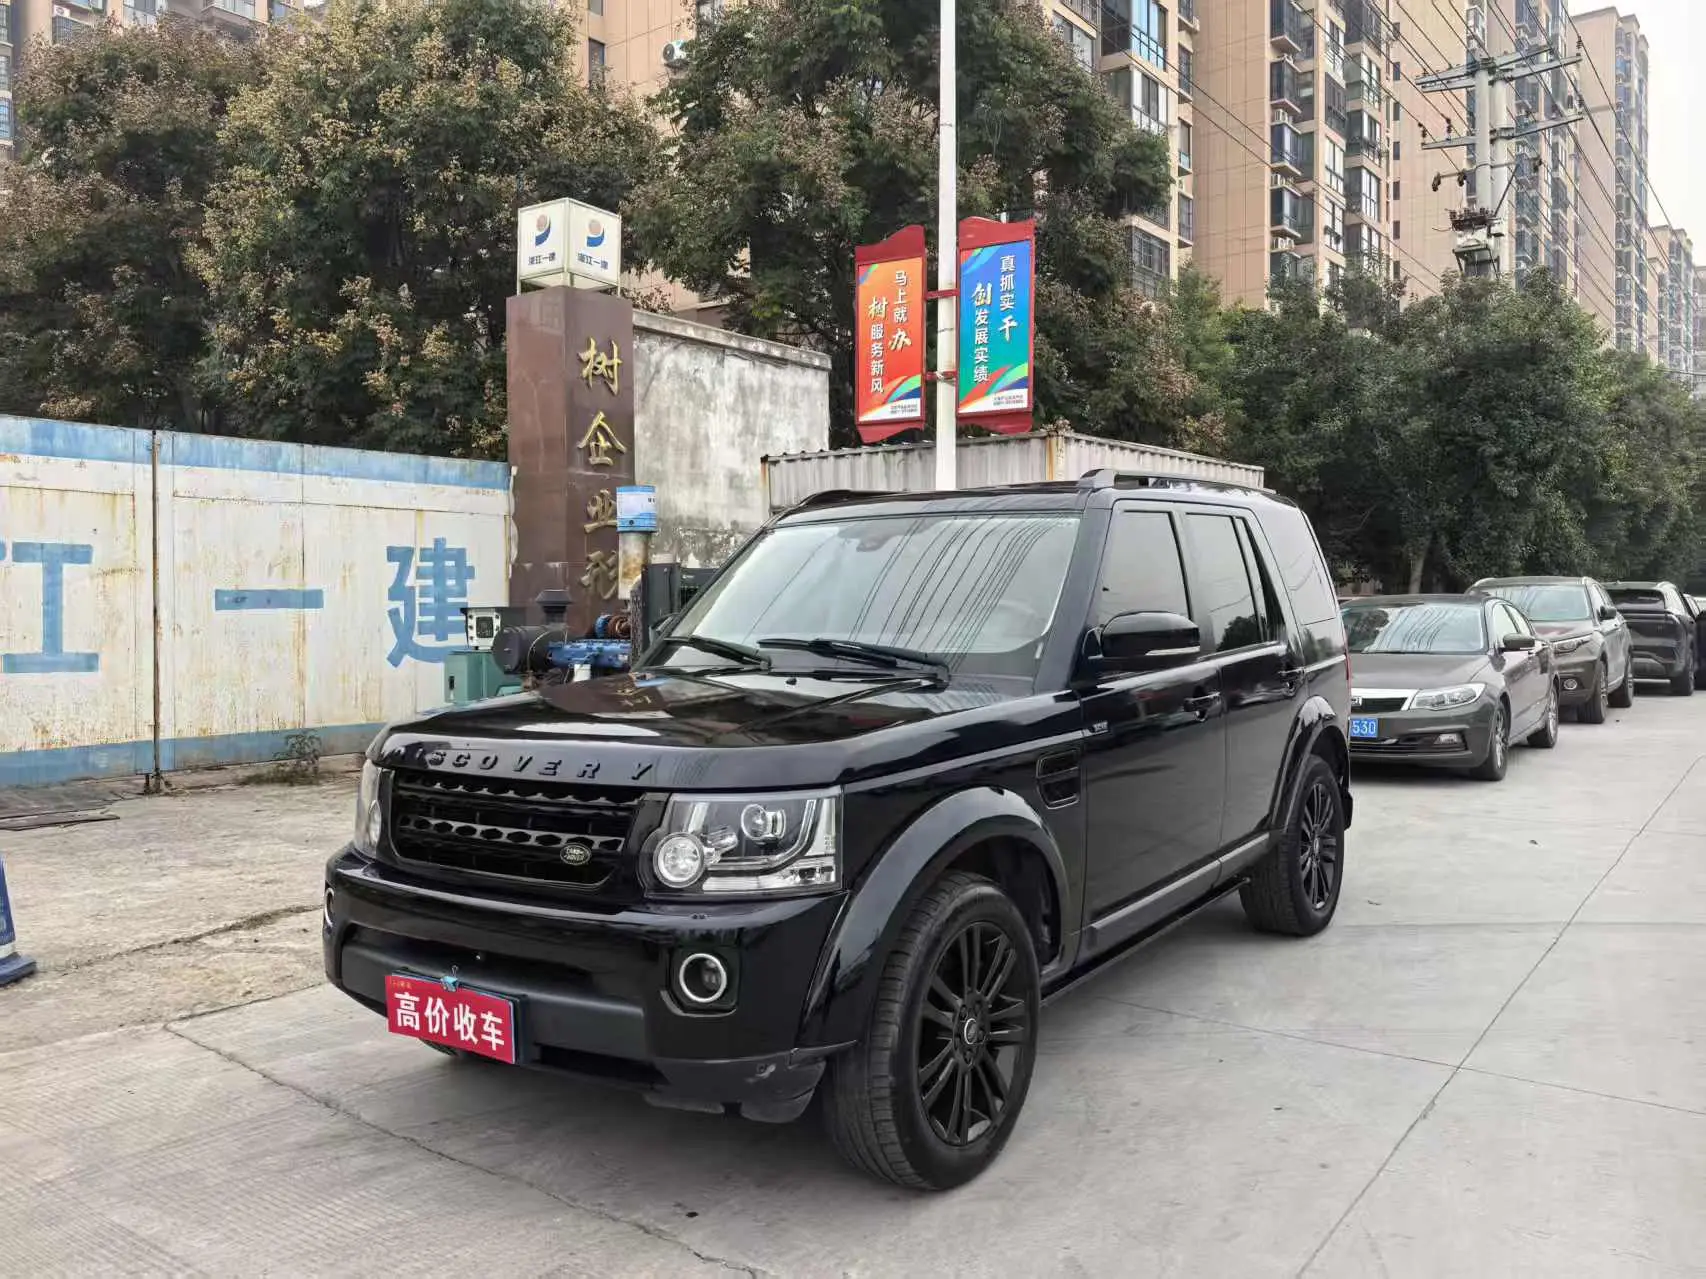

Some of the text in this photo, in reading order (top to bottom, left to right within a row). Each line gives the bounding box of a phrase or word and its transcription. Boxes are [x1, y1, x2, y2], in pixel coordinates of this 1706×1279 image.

[888, 271, 912, 351] 马上就办
[971, 283, 992, 383] 创发展实绩
[998, 255, 1018, 342] 真抓实干
[867, 297, 888, 393] 树服务新风
[394, 991, 505, 1051] 高价收车
